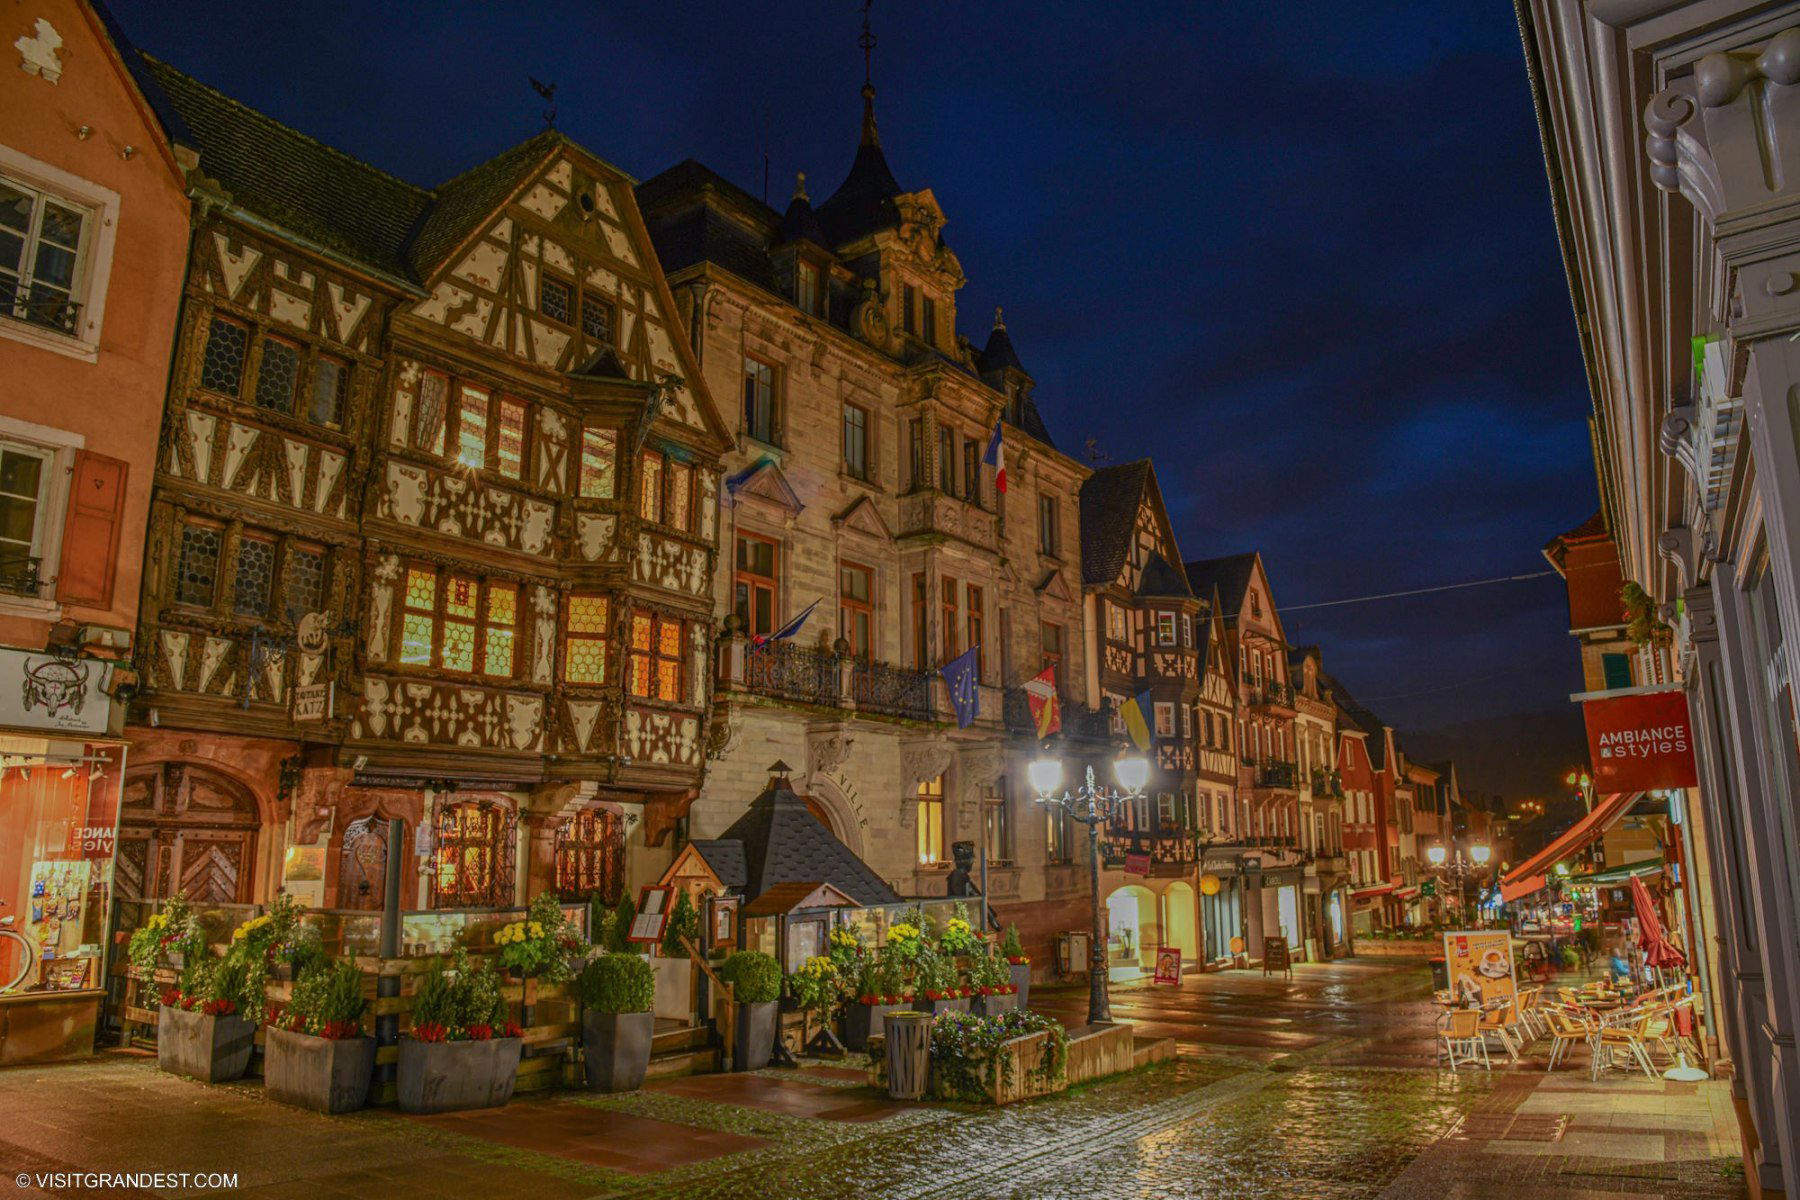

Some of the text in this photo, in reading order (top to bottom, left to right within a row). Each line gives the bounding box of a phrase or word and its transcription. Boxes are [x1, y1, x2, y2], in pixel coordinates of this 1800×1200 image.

[295, 701, 324, 716] KATZ
[1600, 725, 1685, 745] AMBIANCE
[1614, 740, 1687, 758] styles
[840, 774, 868, 829] VILLE
